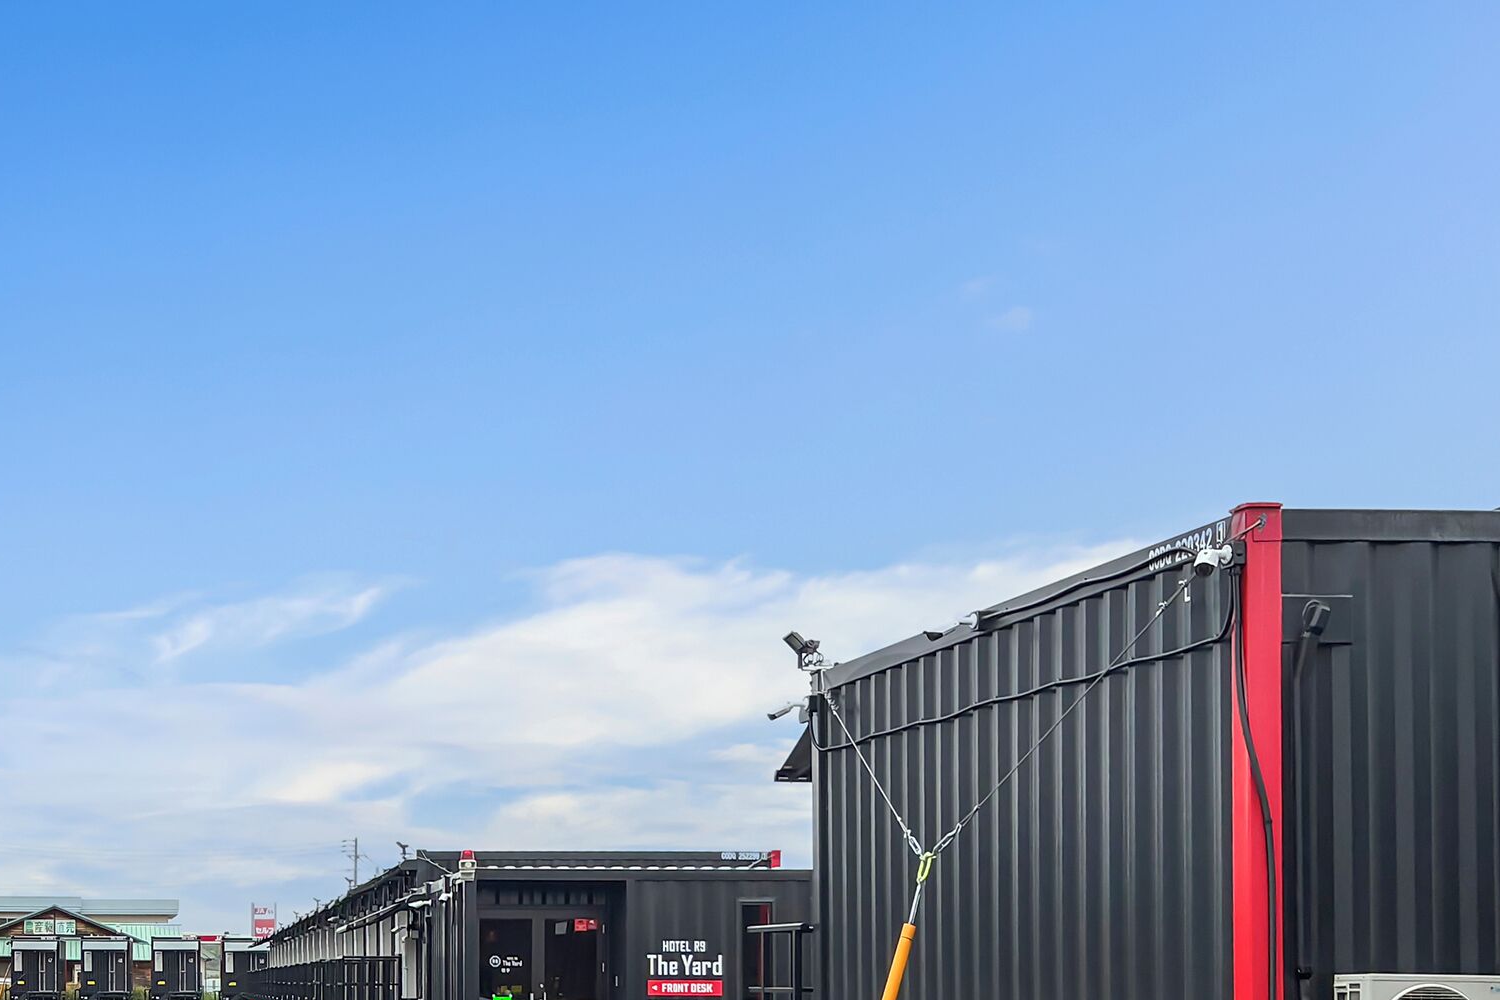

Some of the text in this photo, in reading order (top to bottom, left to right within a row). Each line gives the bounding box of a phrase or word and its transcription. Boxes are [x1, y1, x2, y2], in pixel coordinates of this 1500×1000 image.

[662, 940, 706, 953] HOTEL R9
[646, 954, 723, 976] The Yard
[661, 983, 714, 993] FRONT DESK
